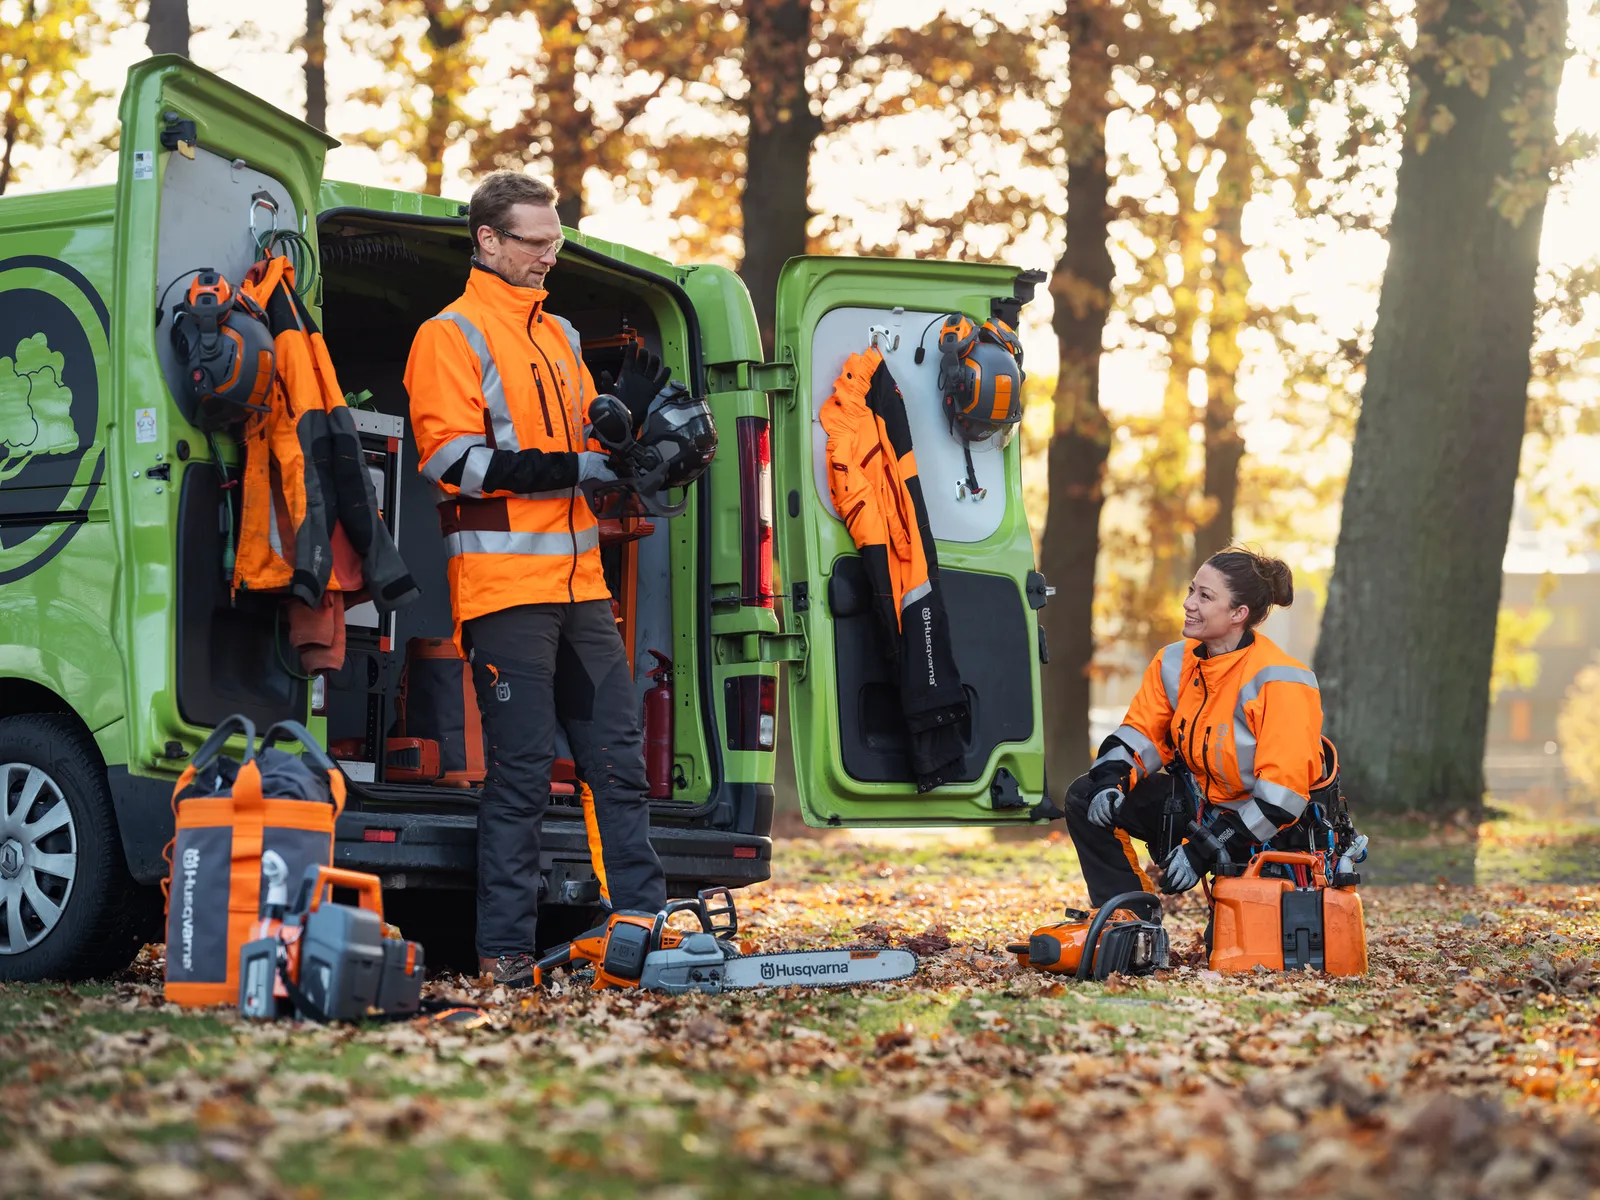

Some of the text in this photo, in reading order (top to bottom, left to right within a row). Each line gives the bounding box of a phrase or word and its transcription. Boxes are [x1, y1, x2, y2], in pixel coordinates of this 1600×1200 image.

[924, 621, 935, 686] Husqvarna
[182, 869, 197, 970] Husqvarna
[776, 963, 849, 977] Husqvarna
